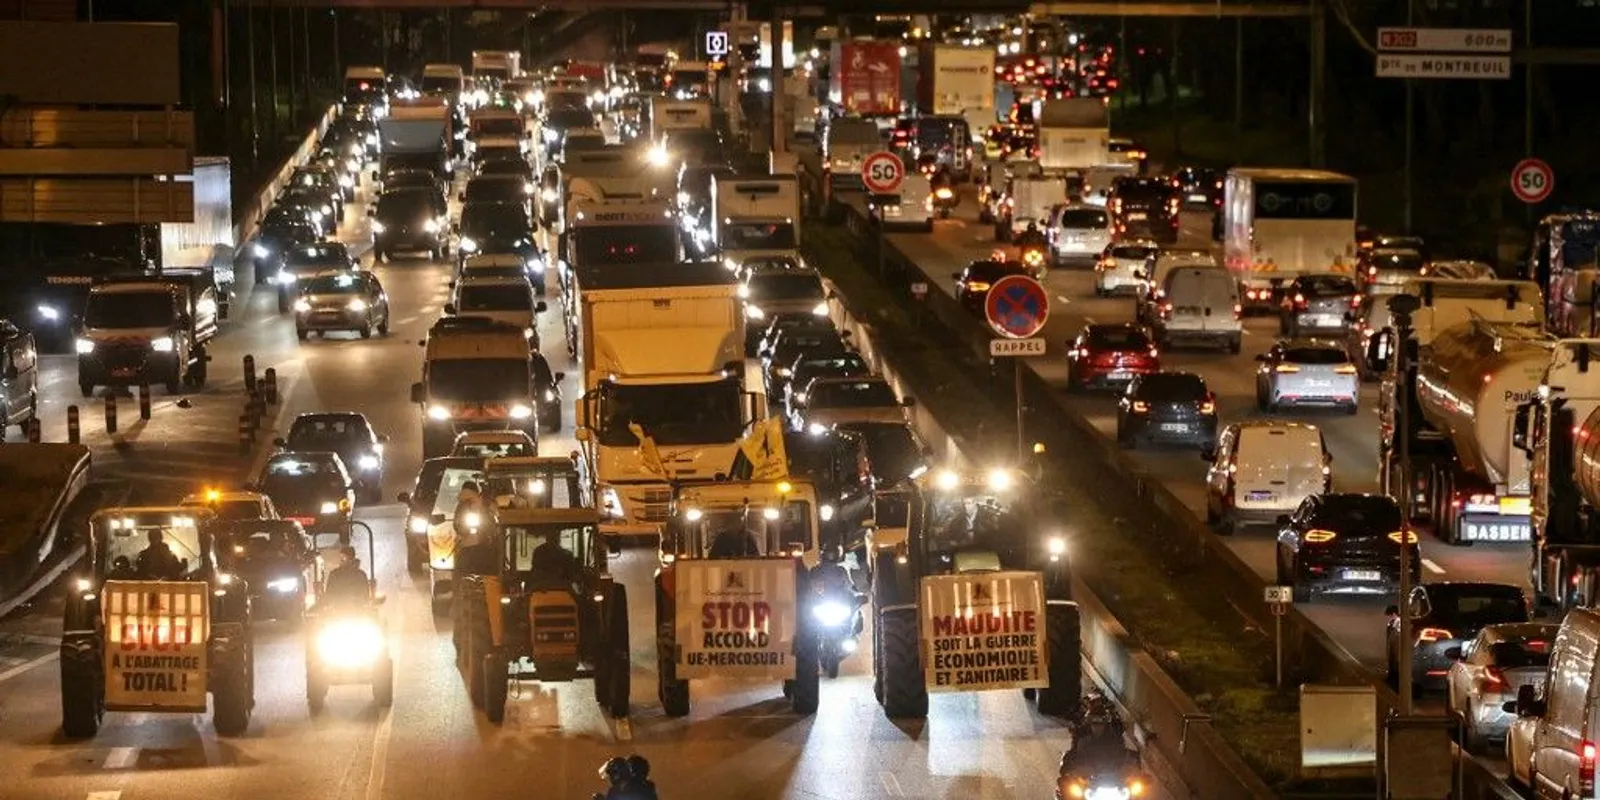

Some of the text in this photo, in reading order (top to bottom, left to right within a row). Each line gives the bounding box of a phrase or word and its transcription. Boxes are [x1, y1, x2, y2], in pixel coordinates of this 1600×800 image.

[1422, 60, 1506, 73] MONTREUIL
[873, 164, 895, 180] 50
[1522, 172, 1544, 189] 50
[995, 342, 1041, 352] RAPPEL
[702, 601, 772, 629] STOP
[933, 611, 1037, 637] MAUDITE
[121, 624, 192, 651] STOP
[704, 631, 770, 649] ACCORD
[934, 634, 1037, 652] SOIT LA GUERRE
[125, 655, 200, 669] L'ABATTAGE
[687, 651, 778, 666] UE-MERCOSUR
[934, 650, 1039, 669] ÉCONOMIQUE
[122, 672, 178, 692] TOTAL
[936, 671, 952, 686] ET
[956, 667, 1029, 685] SANITAIRE
